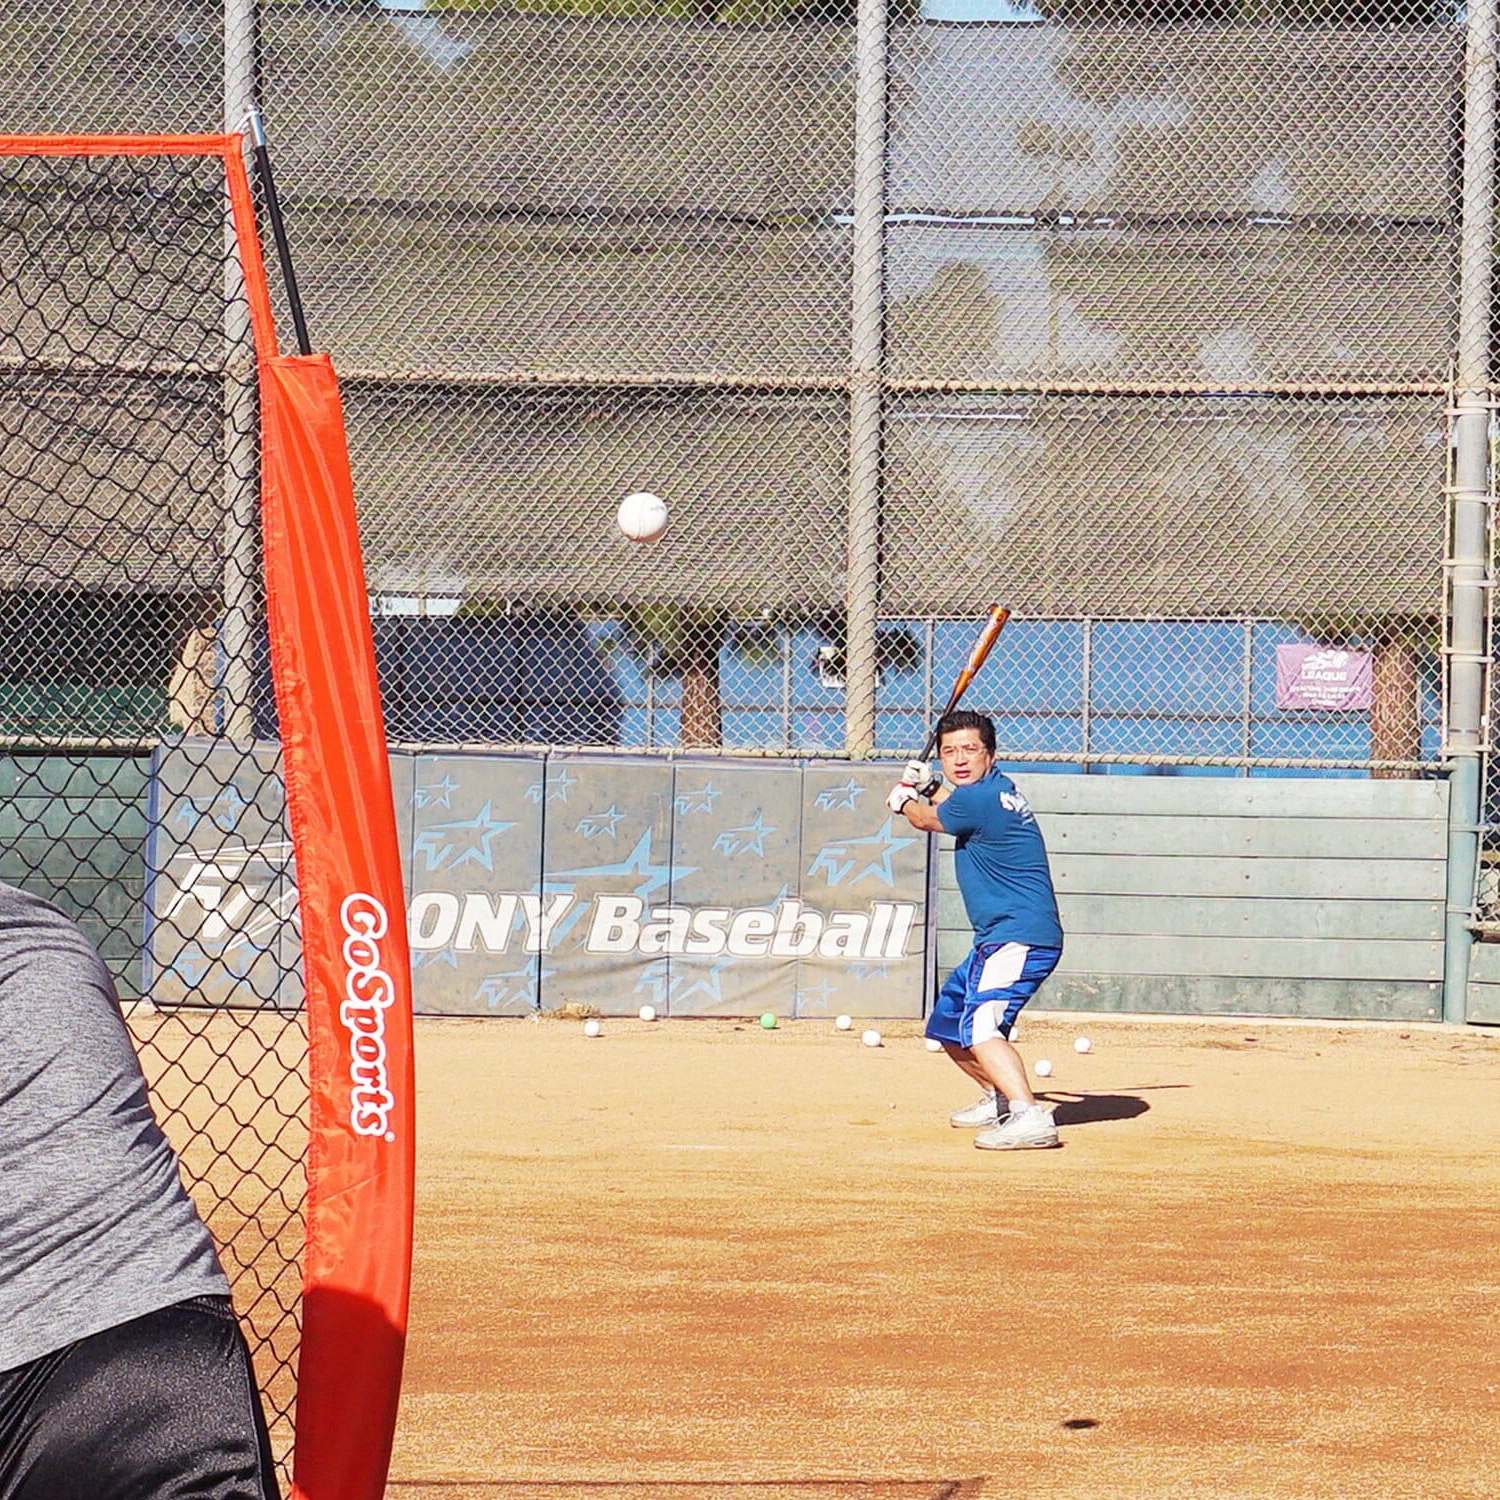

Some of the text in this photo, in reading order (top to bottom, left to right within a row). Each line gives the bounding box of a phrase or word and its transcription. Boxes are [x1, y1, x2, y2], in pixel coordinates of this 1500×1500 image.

[408, 890, 919, 961] ONY Baseball
[340, 892, 395, 1138] GoSports
